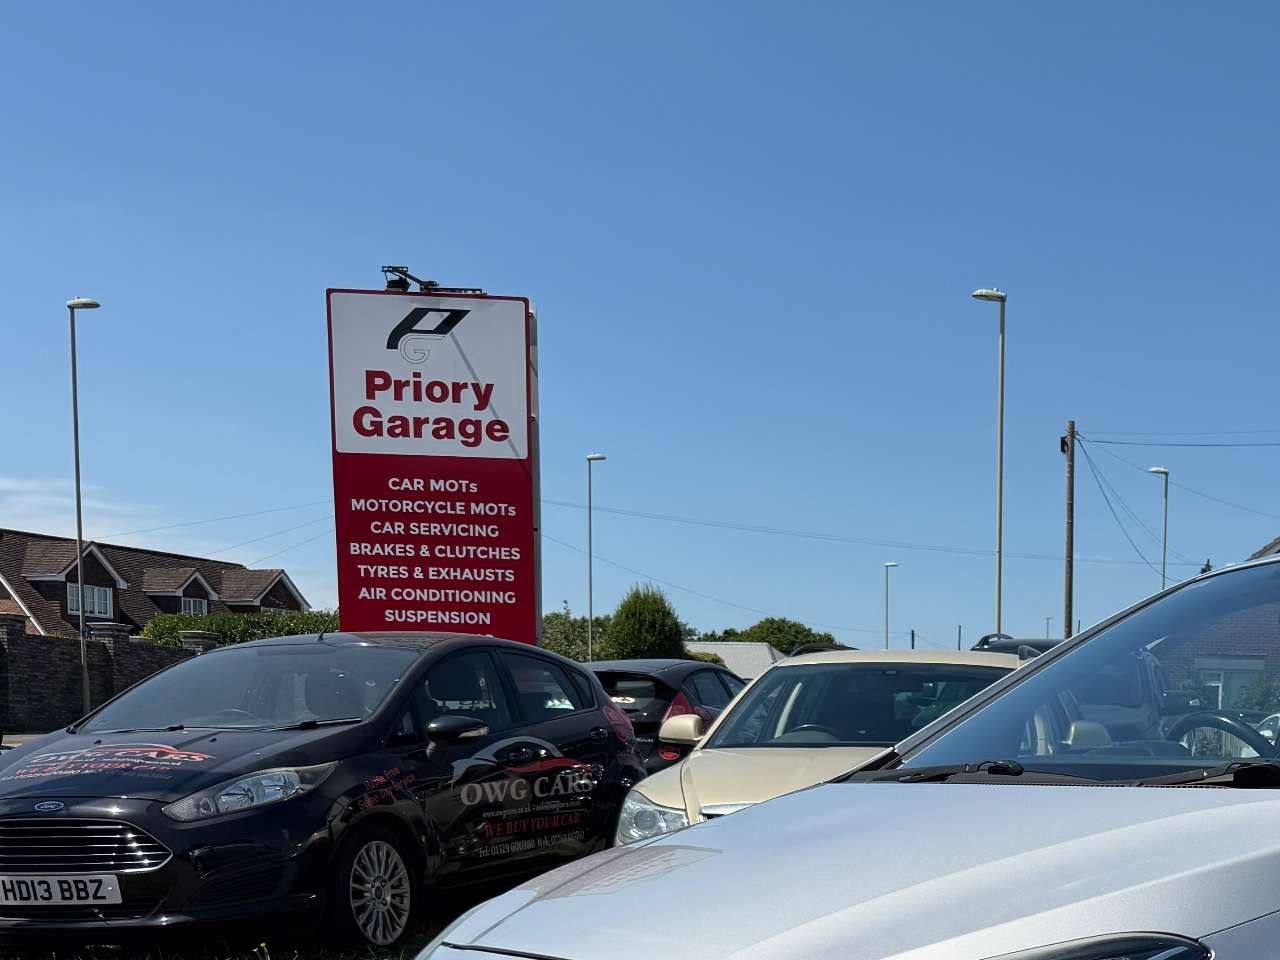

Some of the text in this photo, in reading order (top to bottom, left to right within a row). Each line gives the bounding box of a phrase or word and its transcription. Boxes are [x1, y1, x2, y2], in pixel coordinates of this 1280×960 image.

[365, 370, 494, 411] Priory
[352, 405, 510, 447] Garage
[388, 477, 478, 493] CAR MOTs
[351, 498, 517, 517] MOTORCYCLE MOTs
[370, 521, 499, 538] CAR SERVICING
[350, 542, 521, 560] BRAKES & CLUTCHES
[357, 564, 515, 582] TYRES & EXHAUSTS
[358, 587, 517, 604] AIR CONDITIONING
[384, 609, 491, 625] SUSPENSION
[460, 772, 593, 805] OWG CARS
[507, 820, 530, 834] BUY
[530, 815, 559, 831] YOUR
[560, 813, 581, 826] CAR
[2, 879, 106, 901] HD13 BBZ
